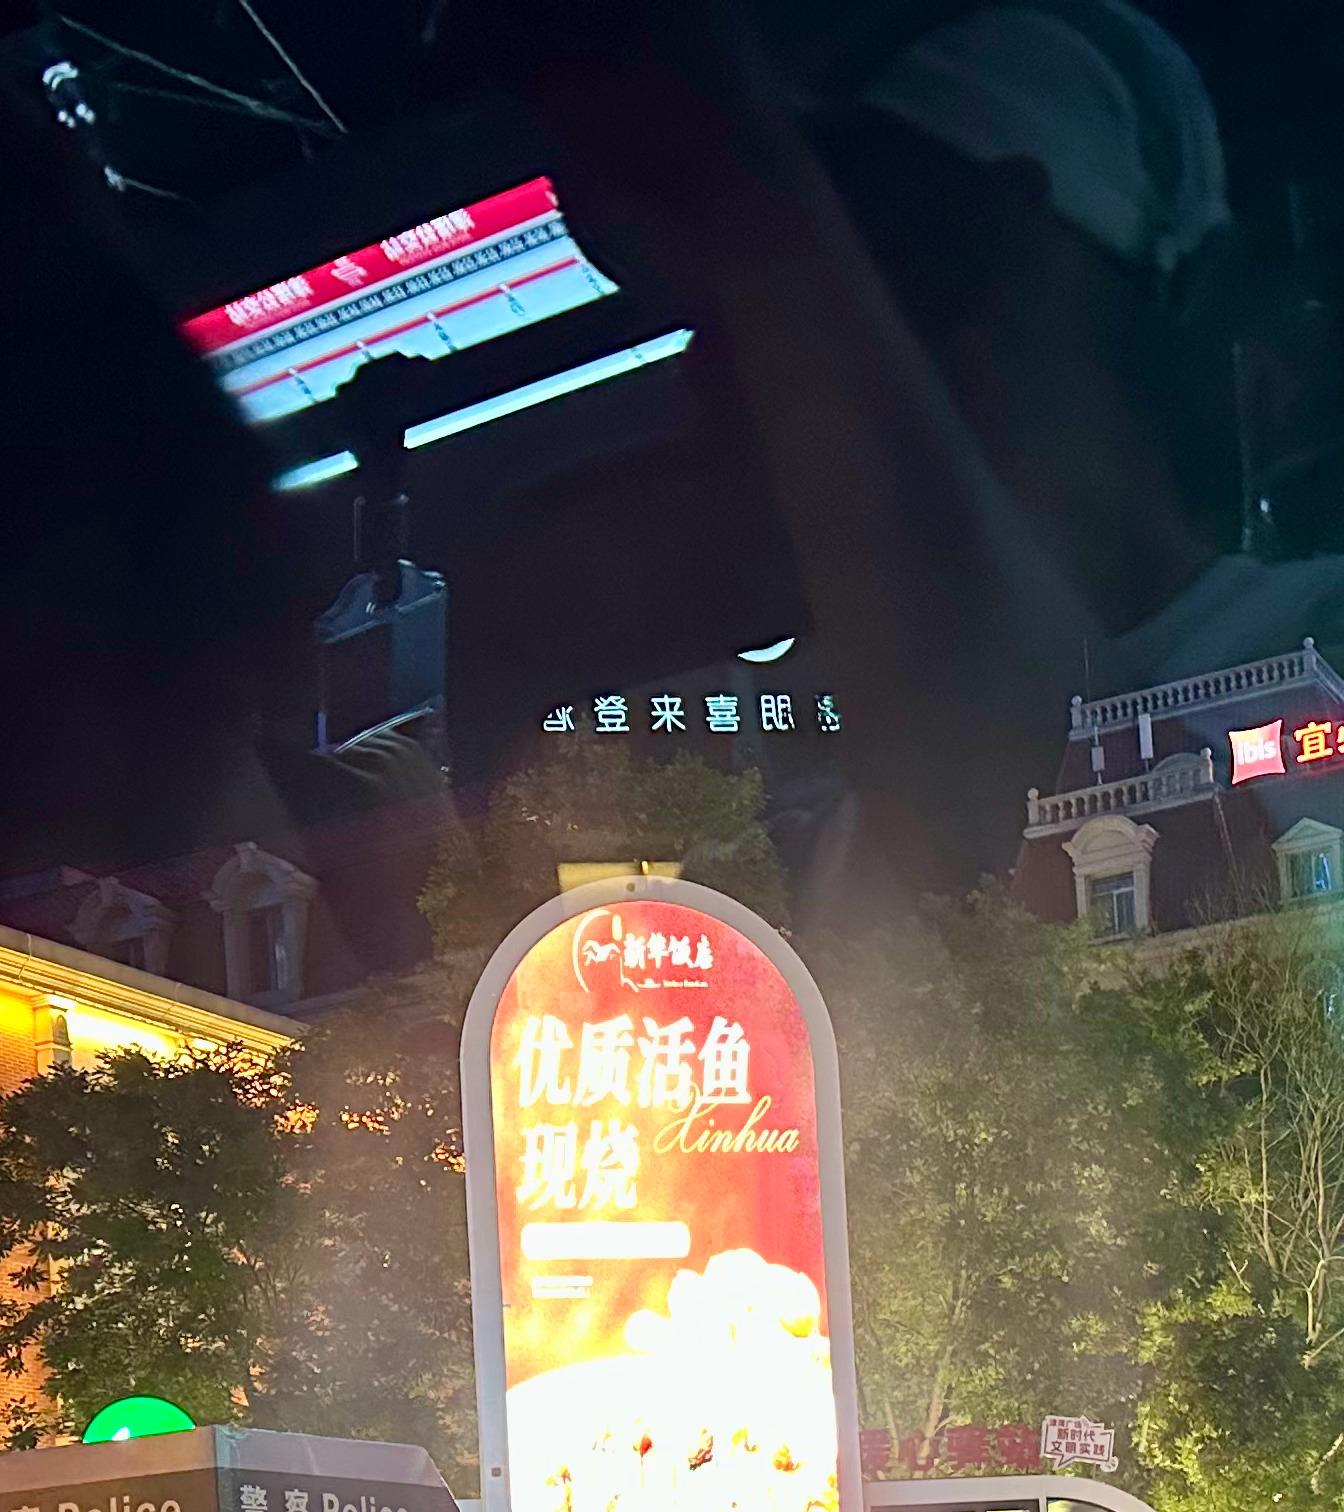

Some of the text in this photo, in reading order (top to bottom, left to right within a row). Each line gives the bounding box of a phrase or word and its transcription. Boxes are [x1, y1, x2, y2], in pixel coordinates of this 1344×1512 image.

[513, 1014, 752, 1110] 优质活鱼
[516, 1118, 640, 1211] 现烧
[654, 1082, 799, 1154] Xinhua
